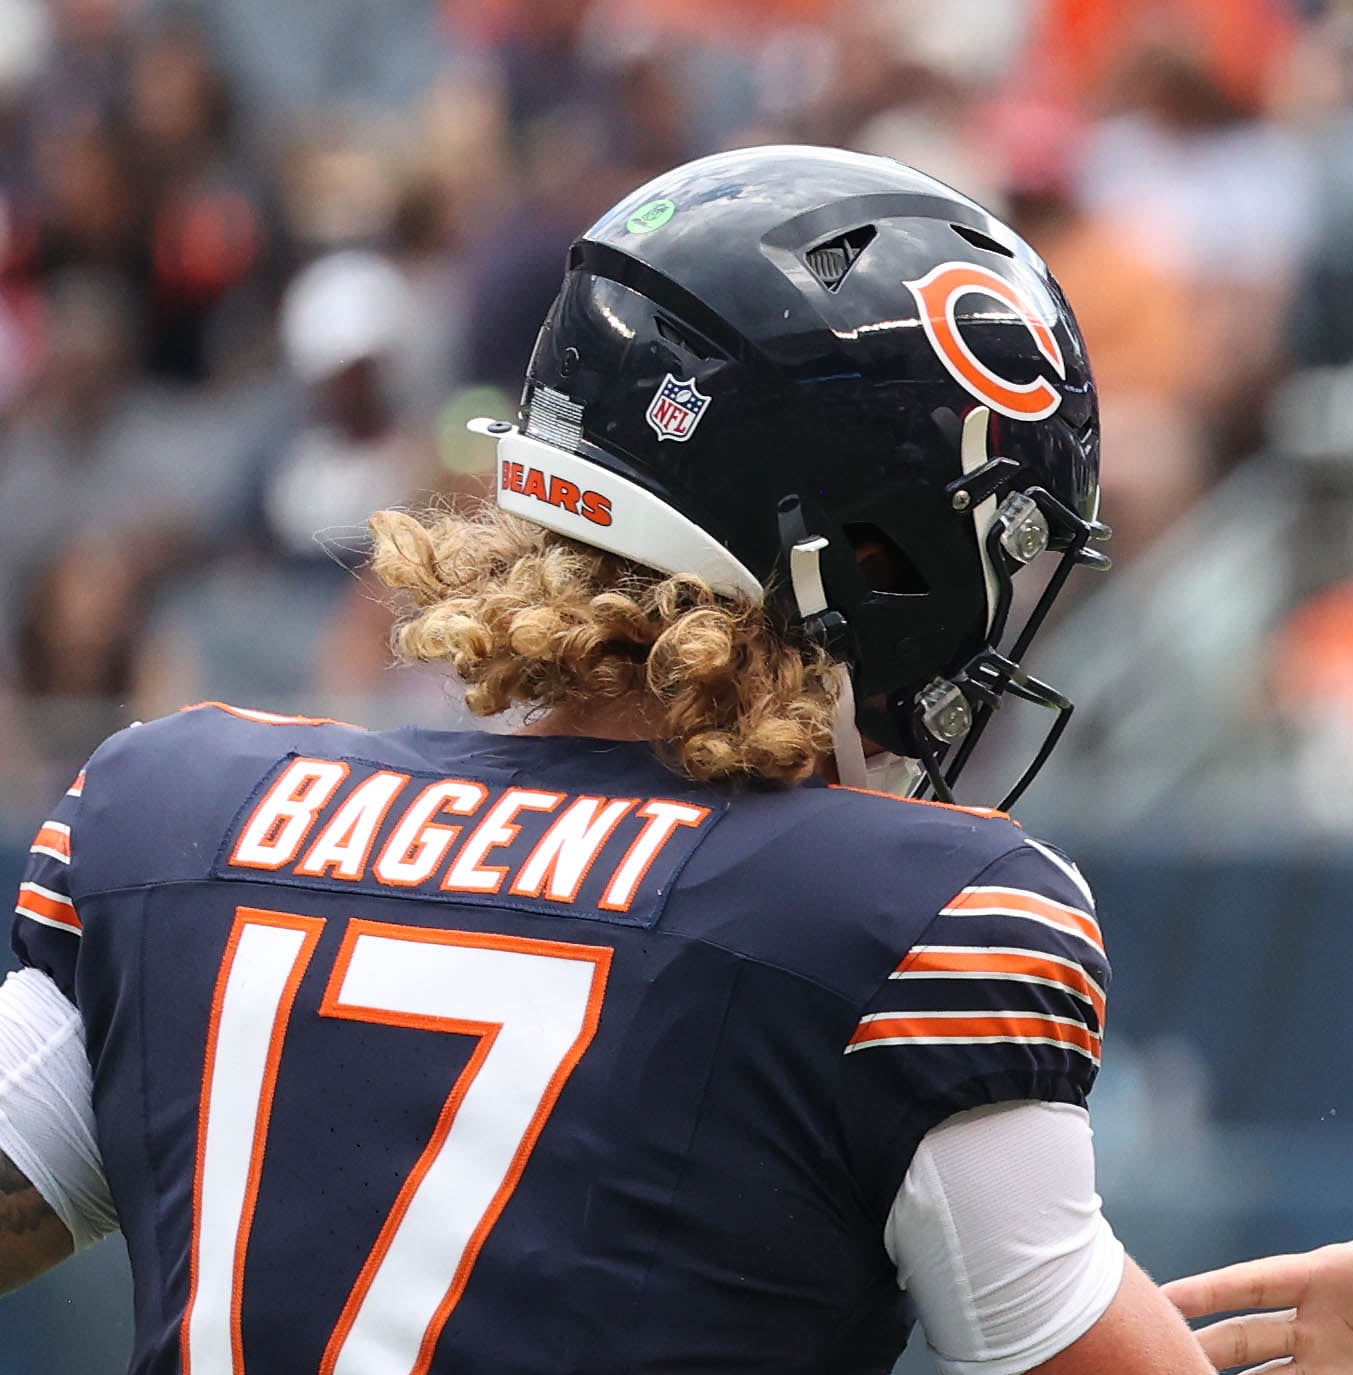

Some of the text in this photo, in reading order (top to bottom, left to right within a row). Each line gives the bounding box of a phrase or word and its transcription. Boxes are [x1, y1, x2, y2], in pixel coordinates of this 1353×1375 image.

[902, 261, 1066, 421] C
[653, 401, 690, 434] NFL
[502, 460, 613, 527] BEARS
[228, 757, 713, 912] BAGENT
